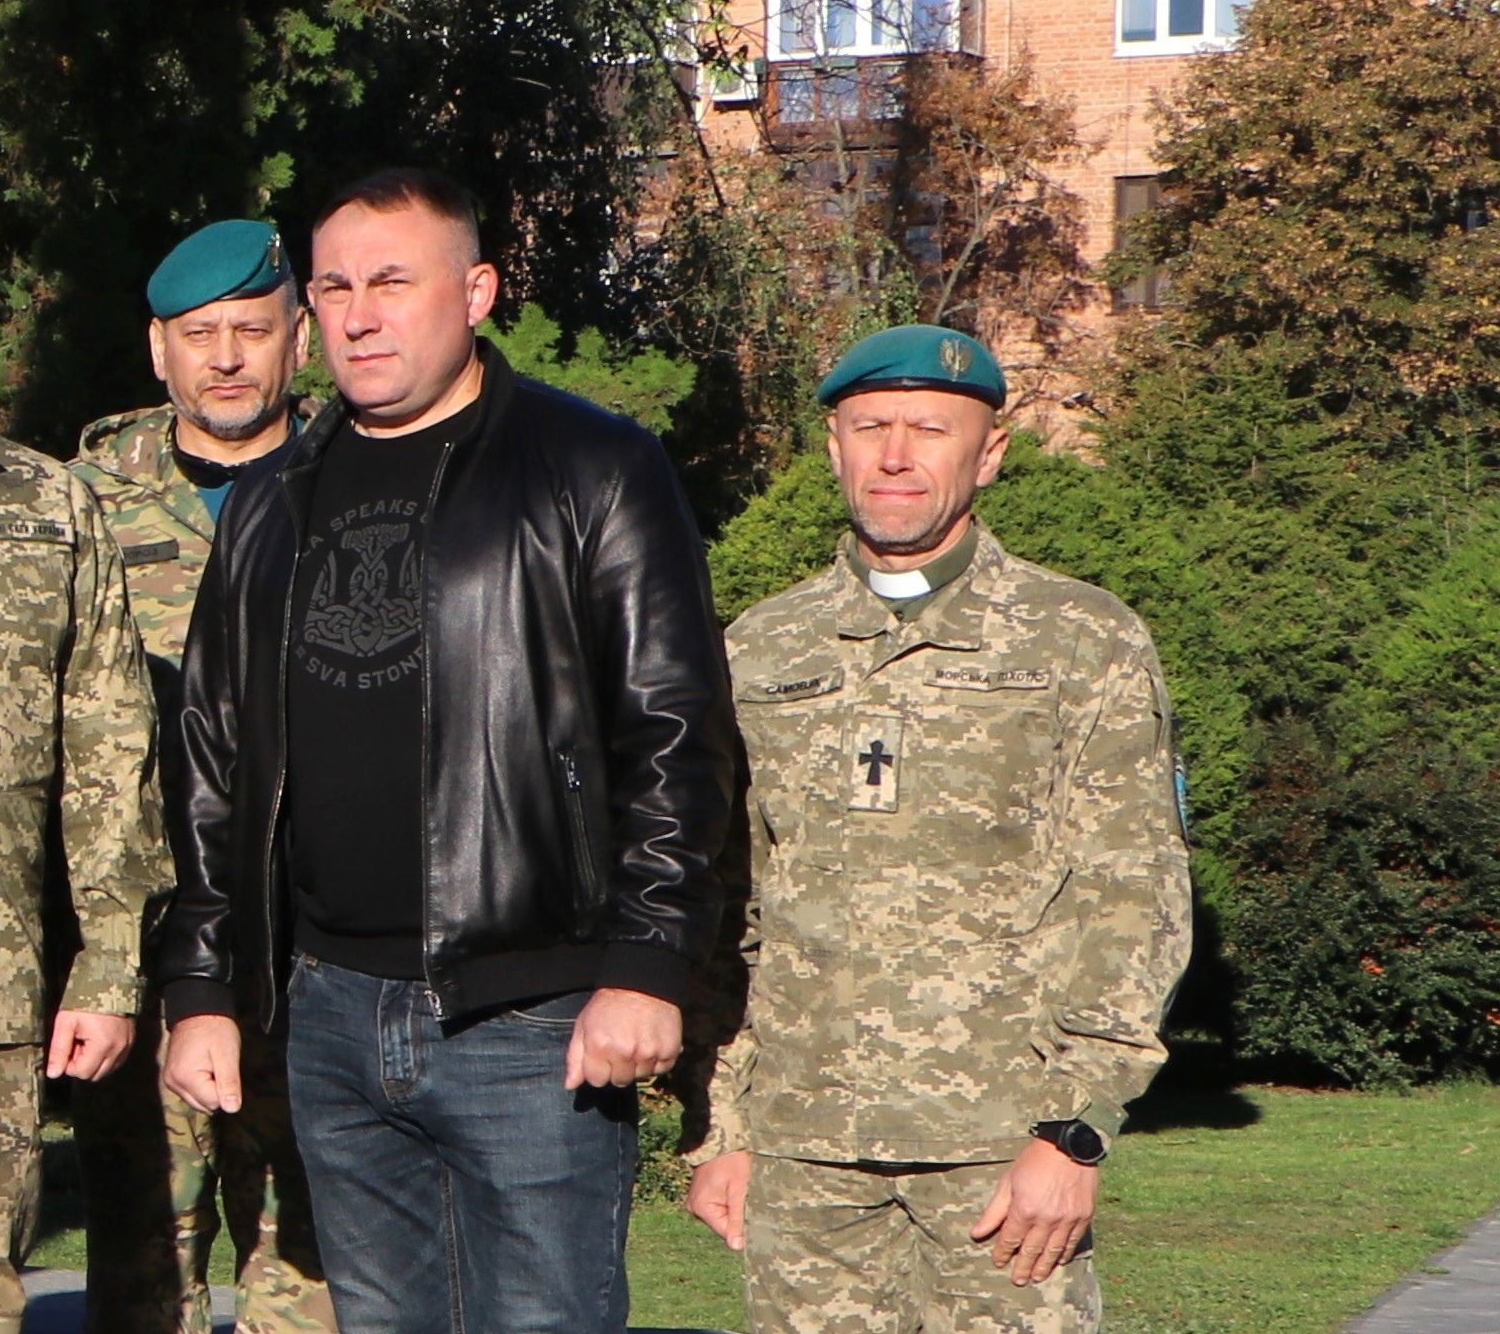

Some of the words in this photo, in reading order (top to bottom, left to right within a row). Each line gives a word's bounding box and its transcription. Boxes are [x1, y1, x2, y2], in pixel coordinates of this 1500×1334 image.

[330, 499, 418, 532] SPEAKS
[306, 657, 347, 687] SVA
[936, 669, 990, 683] МОРСЬКА
